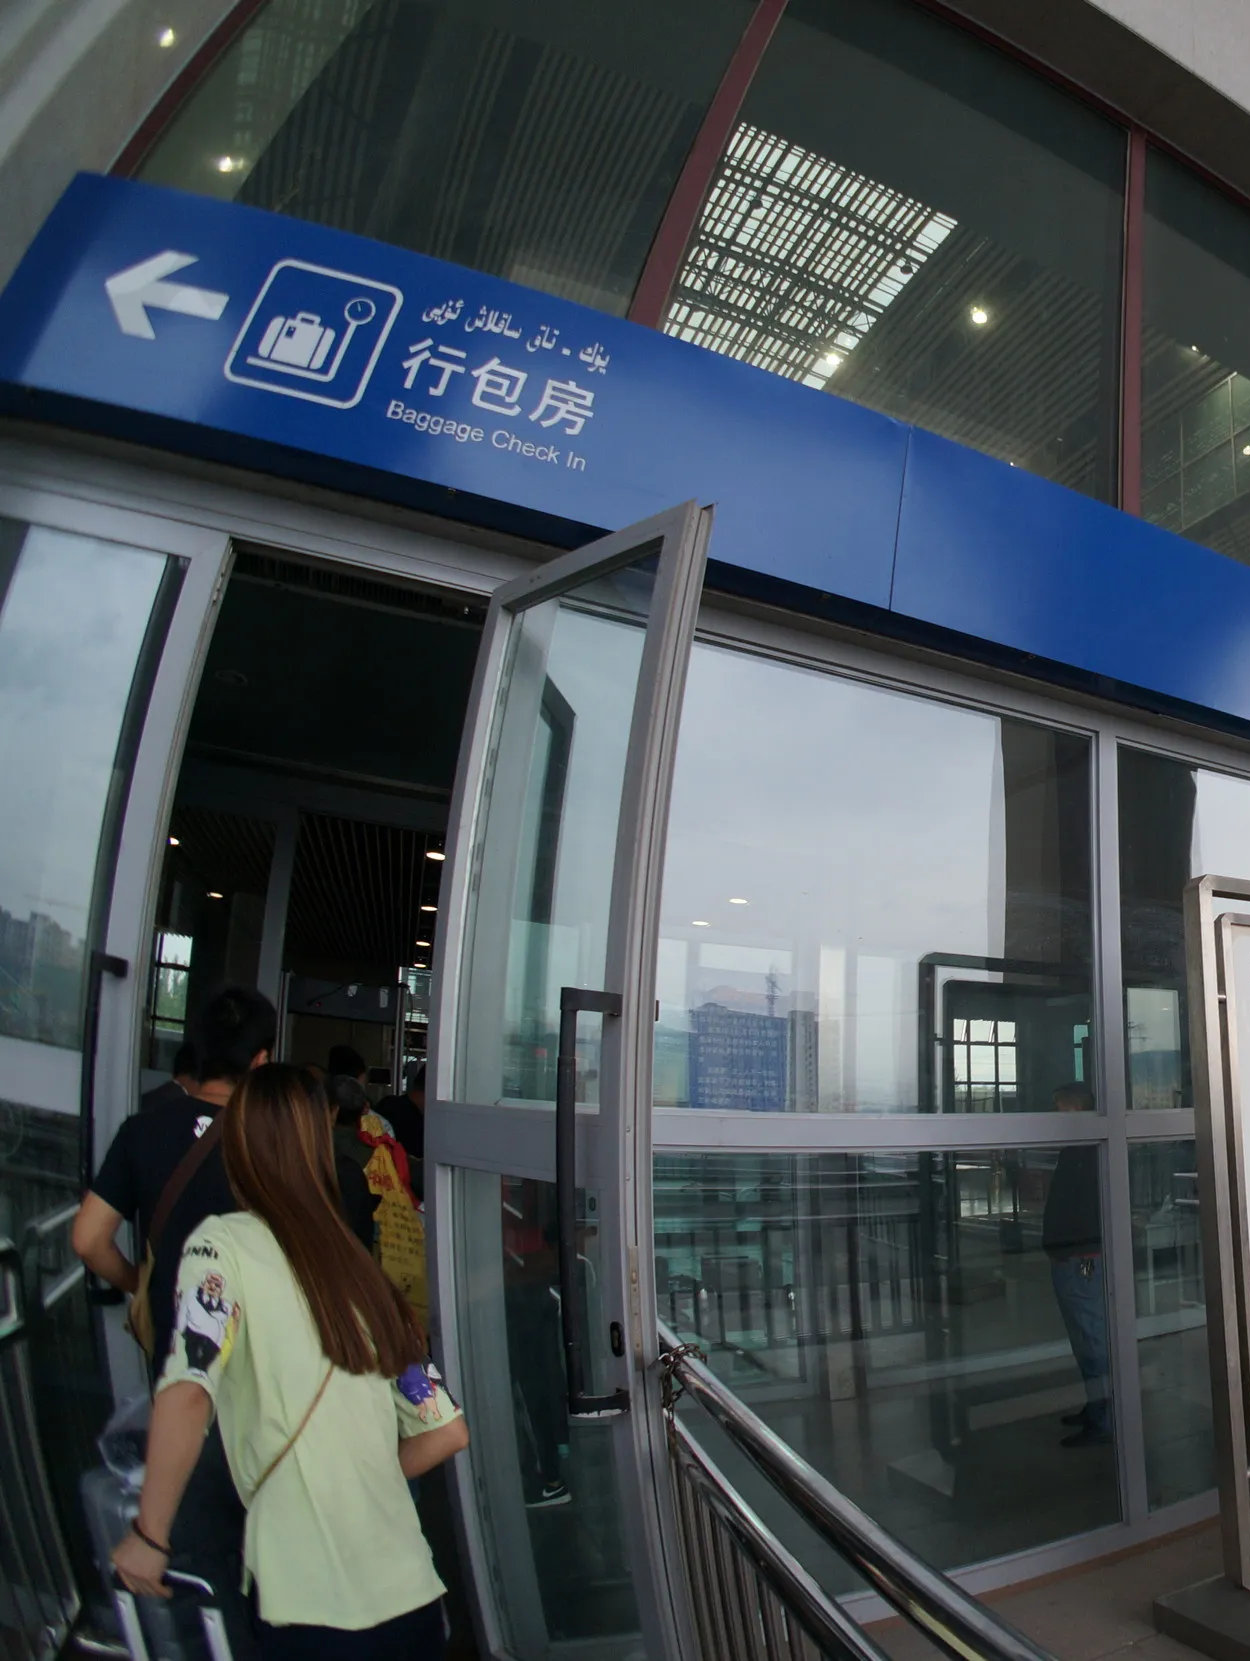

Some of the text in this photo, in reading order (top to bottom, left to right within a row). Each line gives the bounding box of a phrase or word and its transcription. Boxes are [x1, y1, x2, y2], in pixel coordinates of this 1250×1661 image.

[402, 338, 595, 435] 行包房
[386, 399, 587, 472] Baggage Check In
